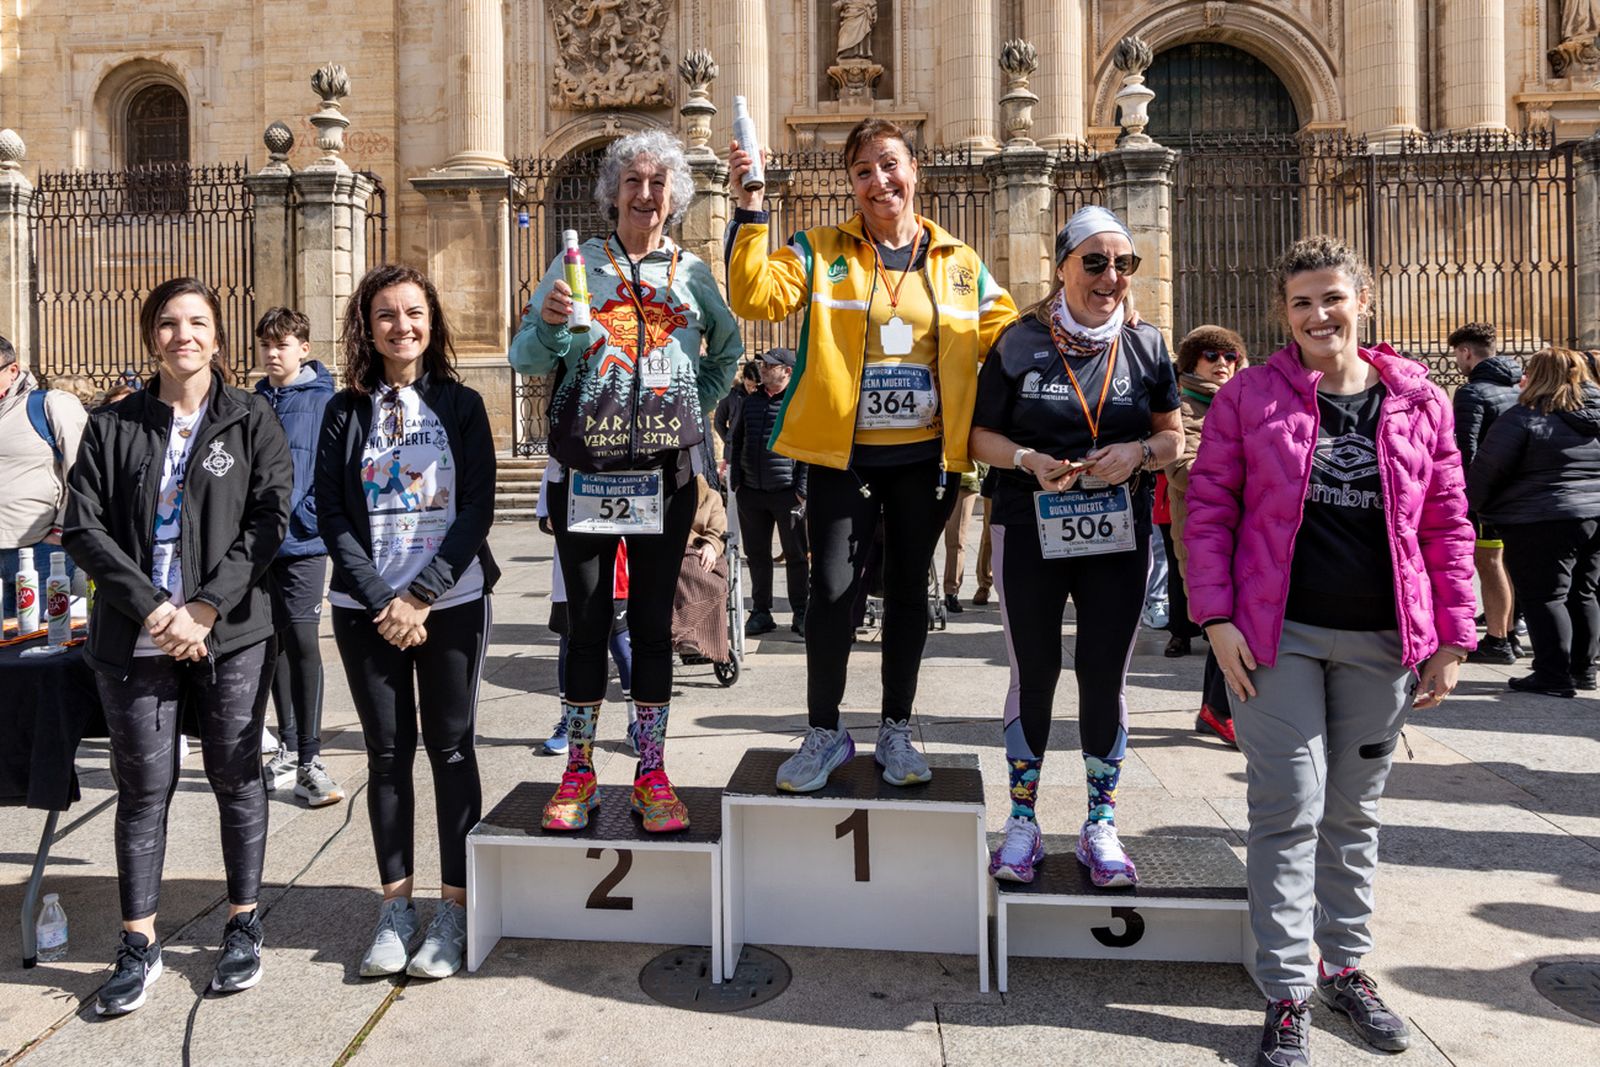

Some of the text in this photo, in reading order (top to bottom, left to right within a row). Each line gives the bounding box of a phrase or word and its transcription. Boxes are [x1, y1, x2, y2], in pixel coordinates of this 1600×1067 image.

[893, 368, 922, 377] CAMINATA
[882, 377, 911, 388] MUERTE
[1041, 383, 1069, 393] LCH
[867, 391, 917, 415] 364
[583, 414, 682, 432] PARAISO
[387, 431, 431, 448] MUERTE
[584, 431, 680, 447] VIRGEN EXTRA
[590, 475, 616, 483] CARRERA
[582, 484, 635, 495] BUENA MUERTE
[1055, 493, 1083, 502] CARRERA
[599, 498, 630, 519] 52
[1049, 501, 1104, 515] BUENA MUERTE
[1061, 514, 1113, 541] 506
[834, 808, 870, 882] 1
[586, 848, 633, 910] 2
[1091, 906, 1145, 948] 3
